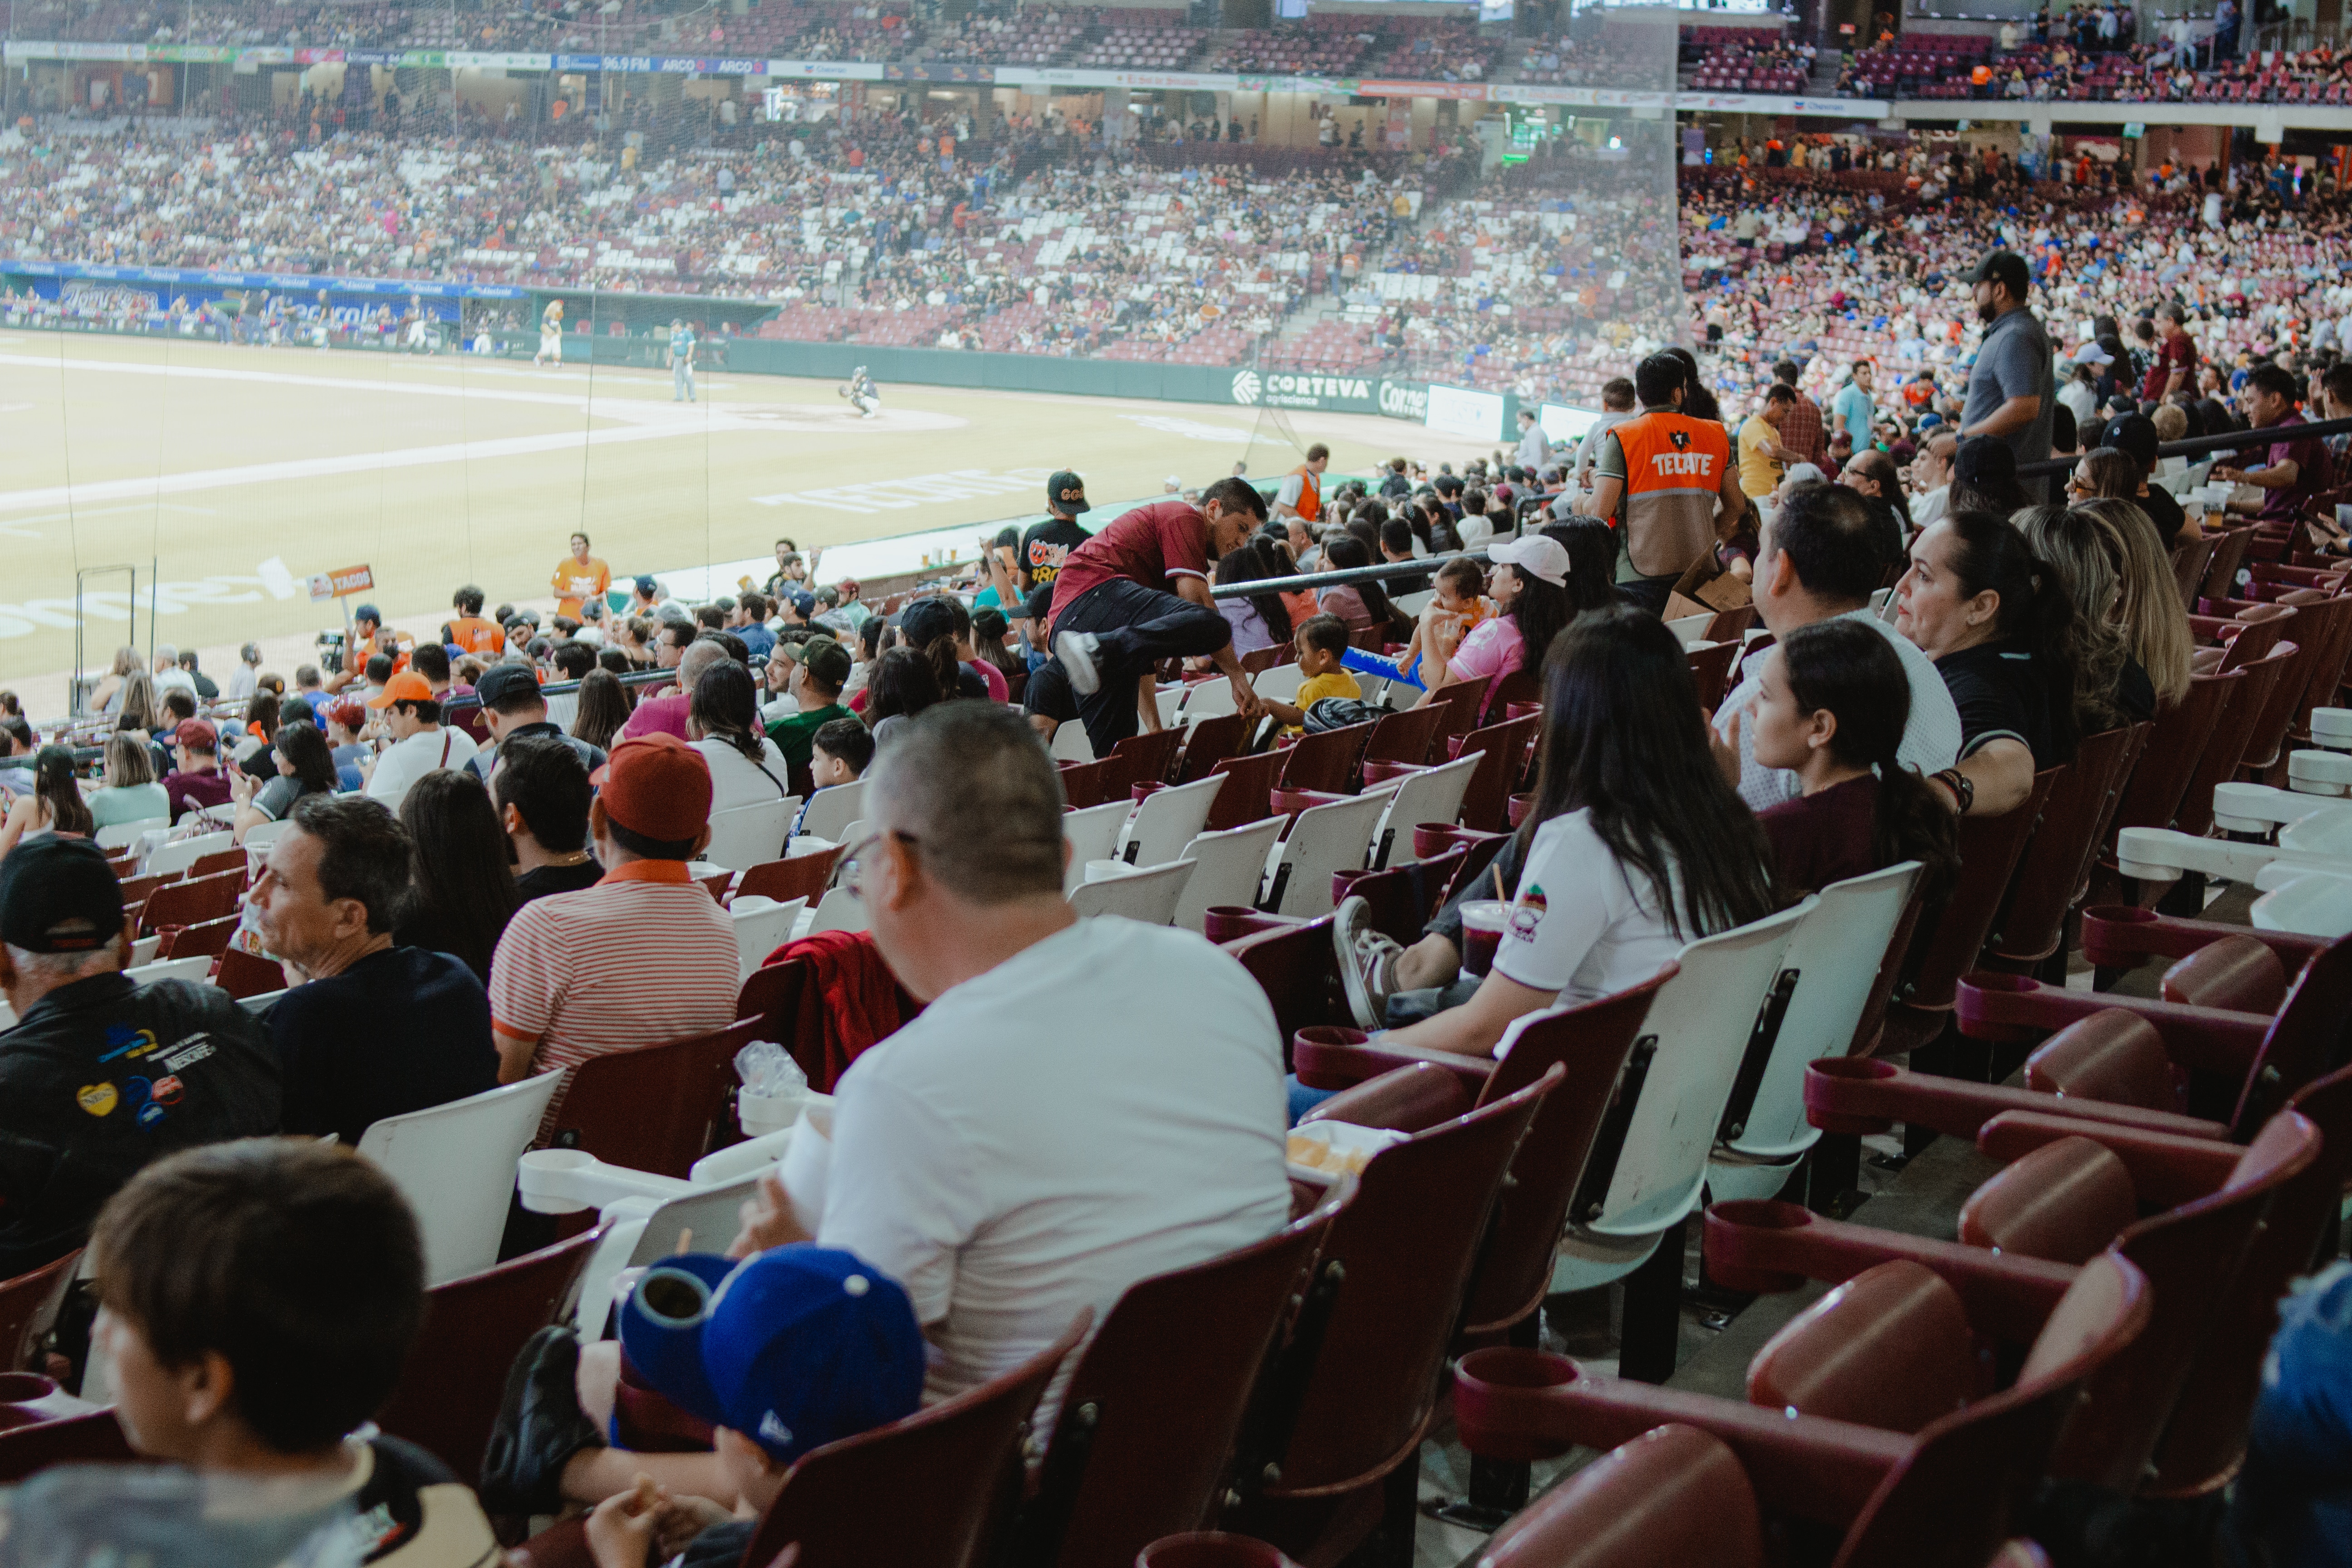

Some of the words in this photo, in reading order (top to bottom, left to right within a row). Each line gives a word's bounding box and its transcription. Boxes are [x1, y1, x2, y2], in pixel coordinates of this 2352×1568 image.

[604, 57, 629, 70] 96.9
[631, 58, 651, 71] FM
[662, 59, 696, 72] ARCO
[719, 61, 753, 73] ARCO
[1266, 374, 1370, 399] CORTEVA
[1265, 394, 1319, 406] agriscience
[1379, 380, 1427, 418] Come
[1651, 452, 1715, 476] TECATE
[333, 571, 371, 590] TACOS
